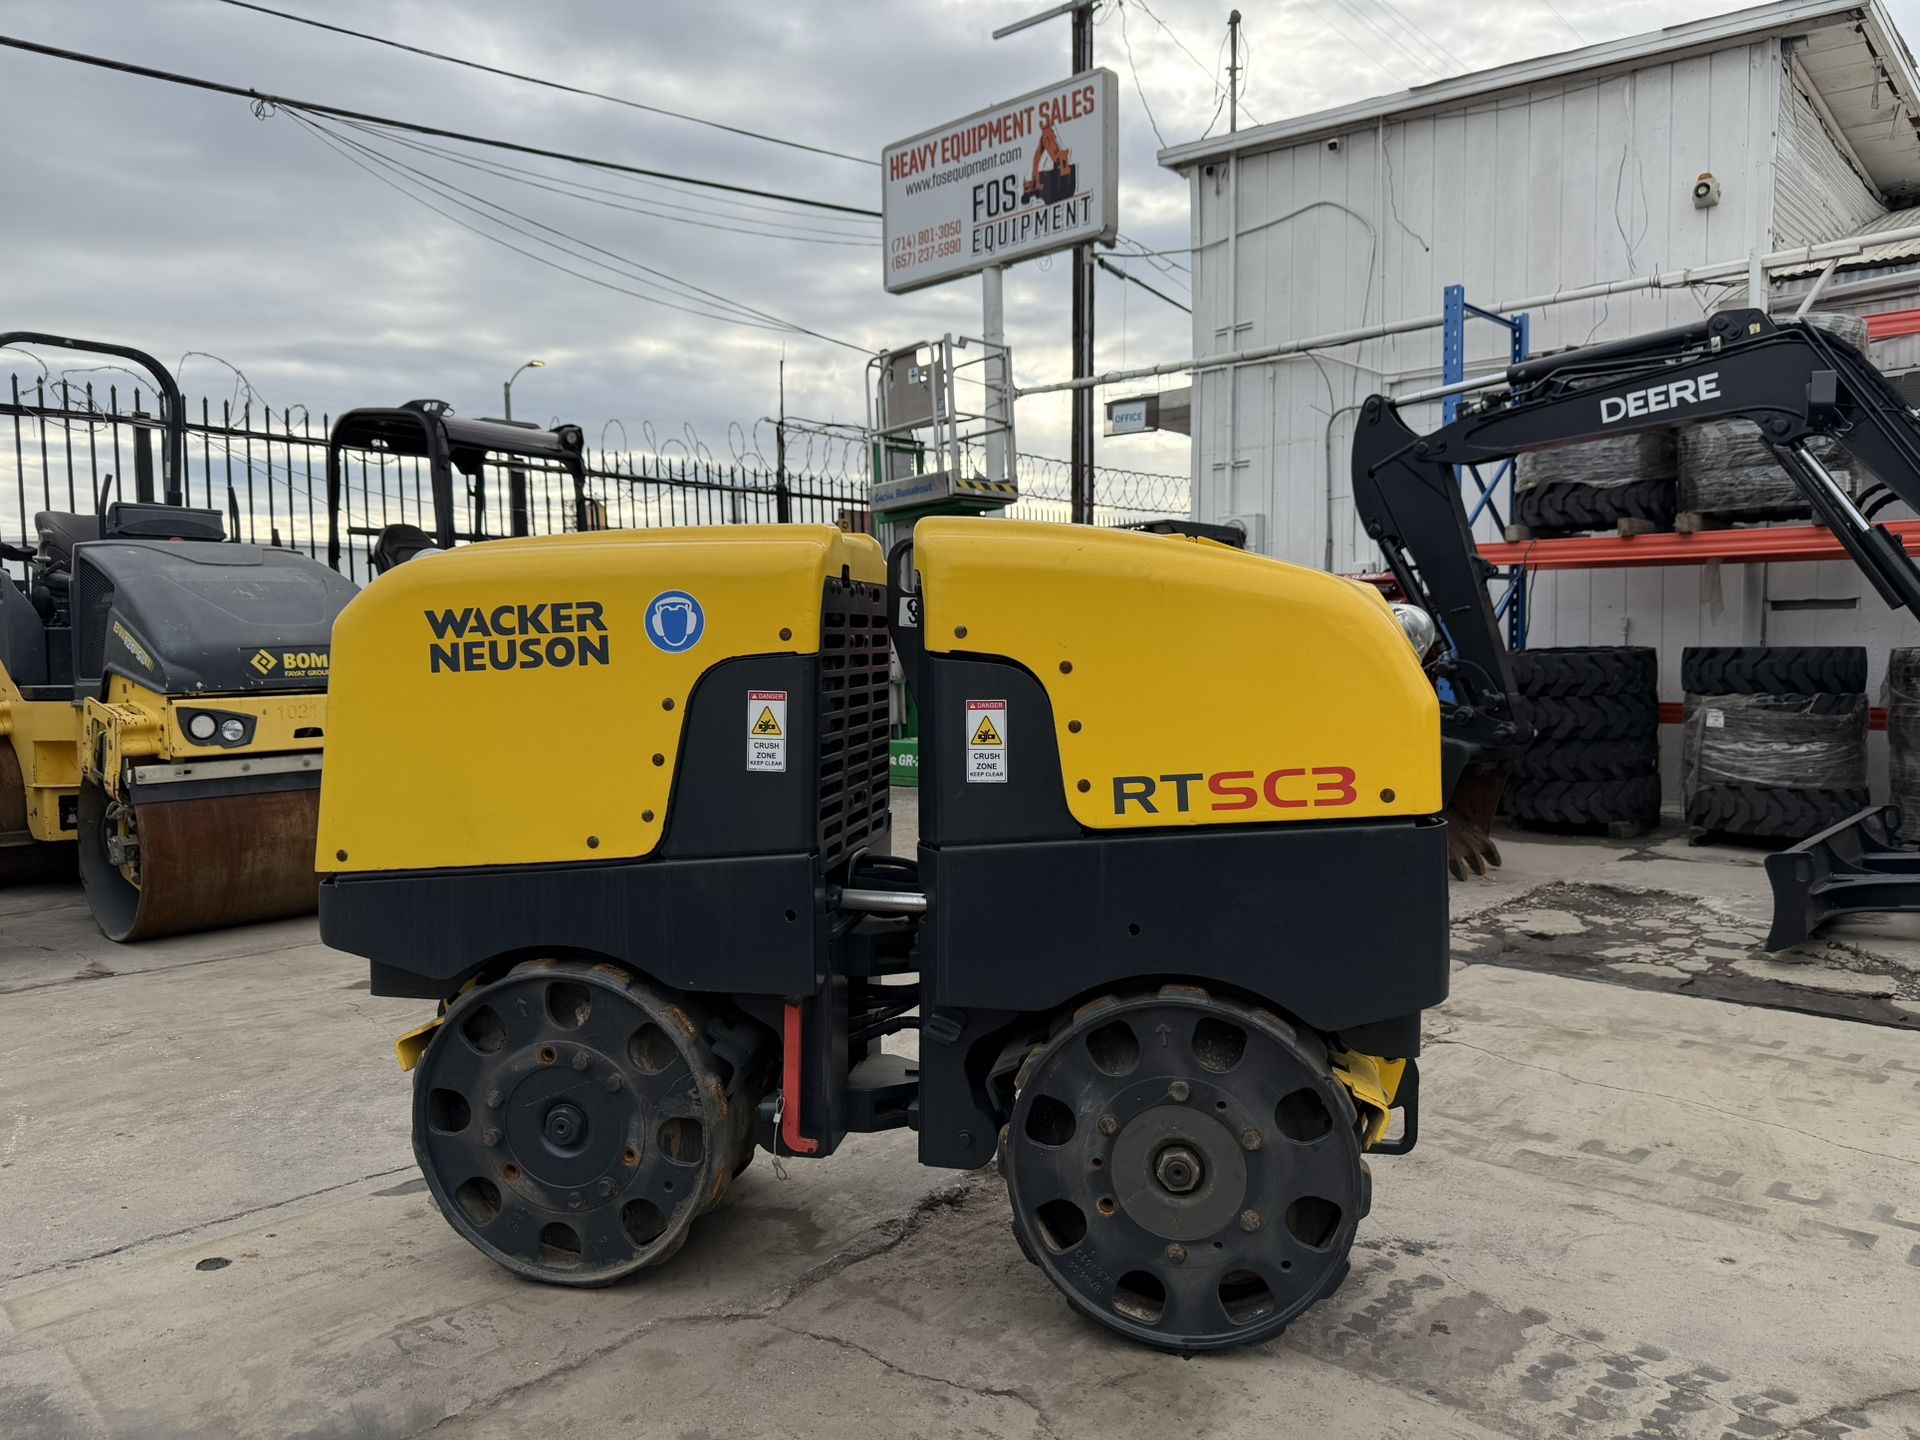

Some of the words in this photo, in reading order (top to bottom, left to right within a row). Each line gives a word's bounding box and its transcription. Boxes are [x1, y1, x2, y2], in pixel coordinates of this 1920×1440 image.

[890, 141, 937, 181] HEAVY
[941, 106, 1034, 164] EQUIPMENT
[1039, 85, 1094, 130] SALES
[905, 147, 1022, 197] www.fosequipment.com
[972, 174, 1016, 222] FOS
[892, 234, 916, 255] (714)
[918, 219, 962, 246] 801-3050
[972, 196, 1091, 254] EQUIPMENT
[892, 252, 916, 272] (657)
[1114, 411, 1143, 424] OFFICE
[1599, 372, 1721, 424] DEERE
[424, 601, 608, 639] WACKER
[430, 635, 609, 673] NEUSON
[976, 762, 998, 770] ZONE
[1112, 766, 1358, 815] RTSC3
